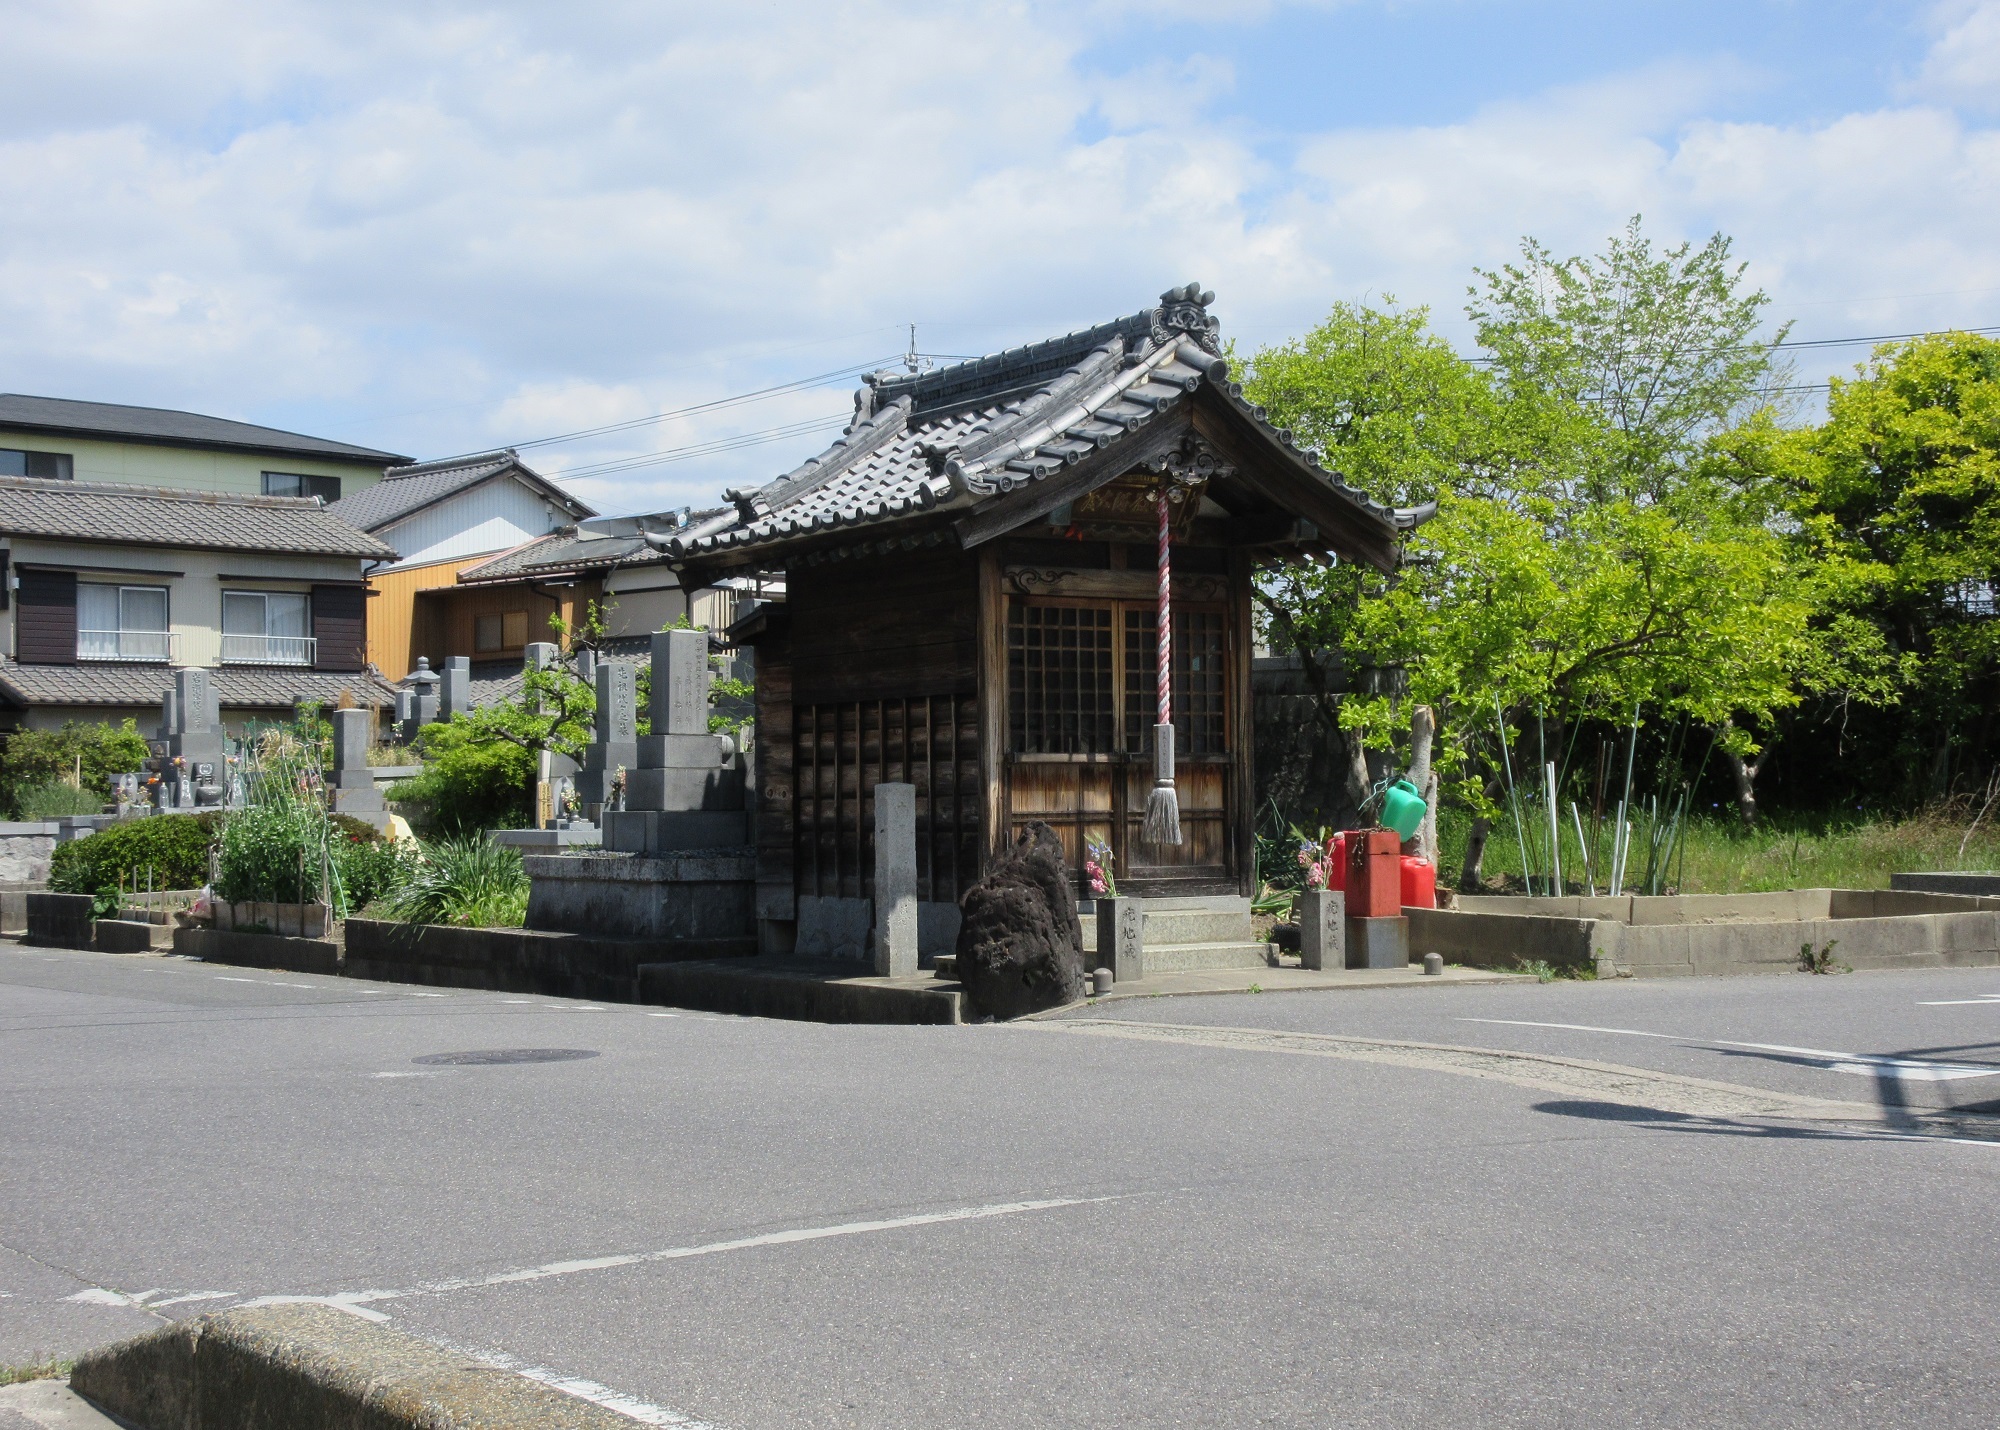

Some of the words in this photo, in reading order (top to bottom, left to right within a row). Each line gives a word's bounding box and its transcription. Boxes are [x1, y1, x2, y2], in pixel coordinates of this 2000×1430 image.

[617, 666, 629, 737] 先祖代々之墓
